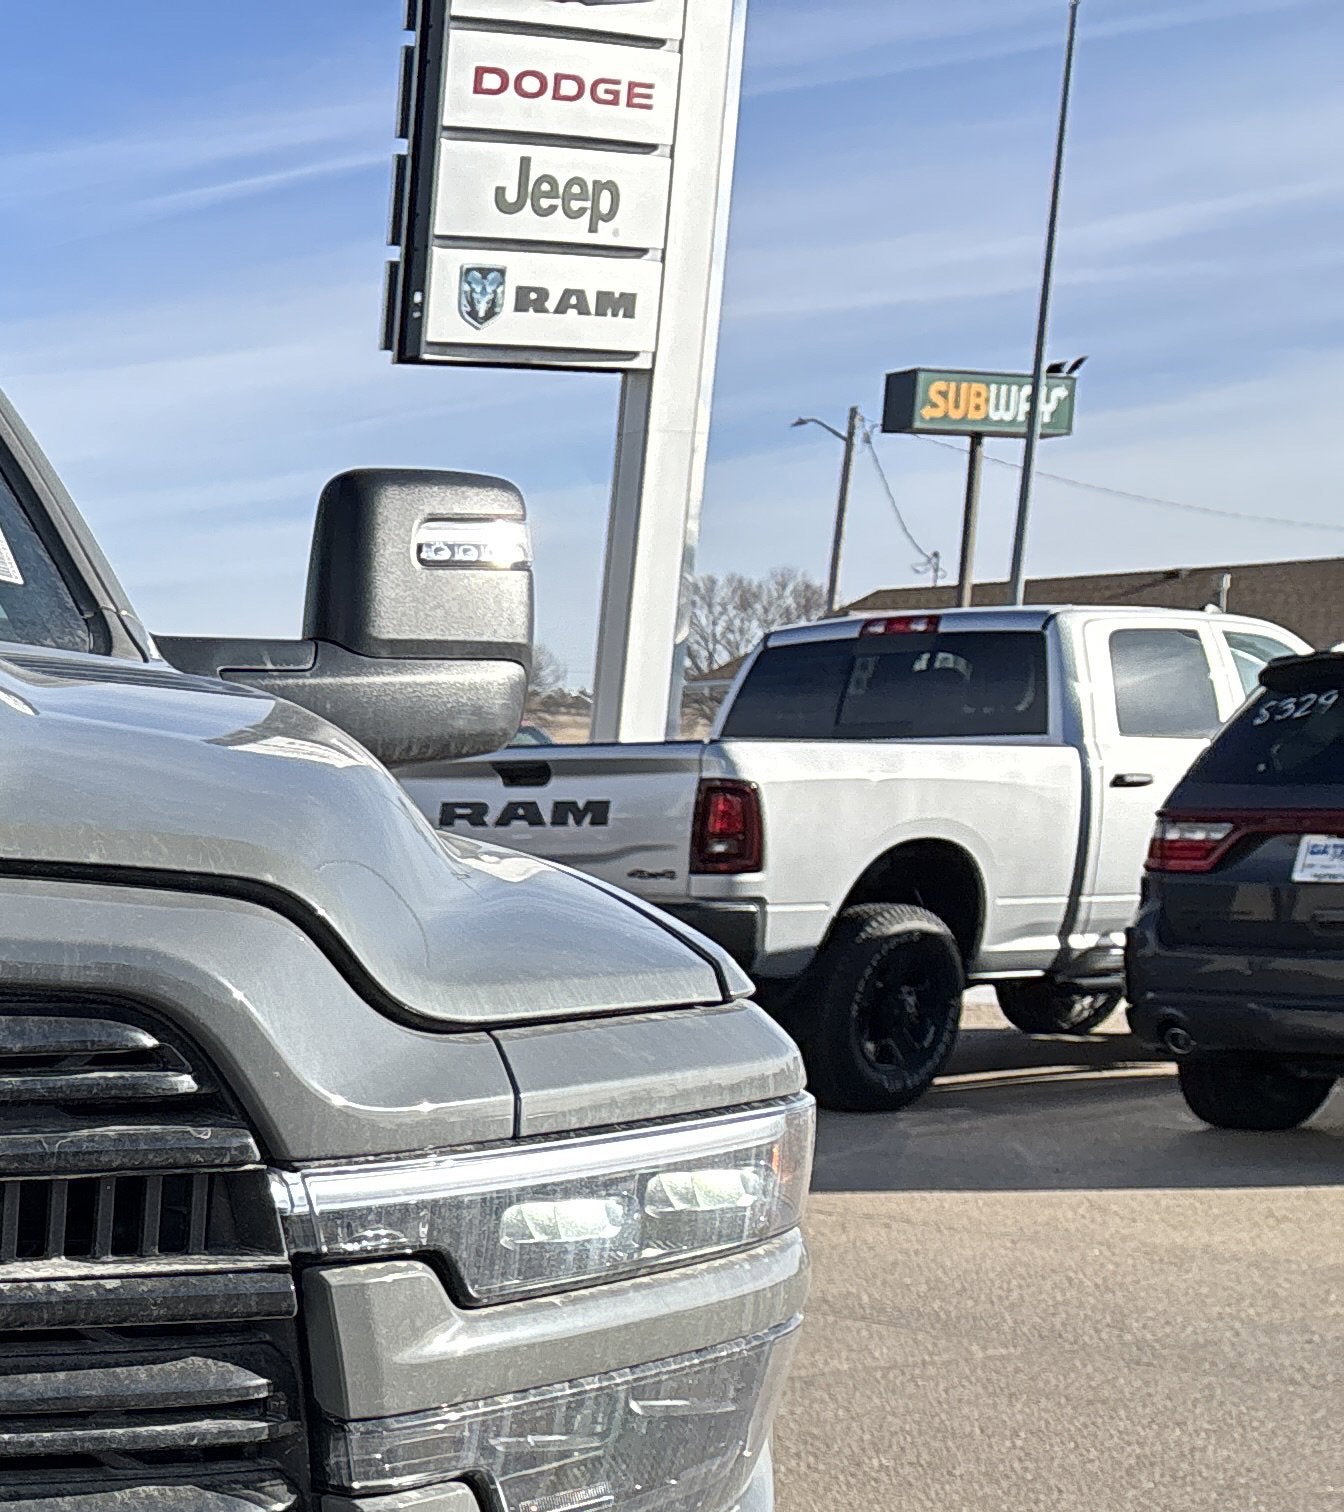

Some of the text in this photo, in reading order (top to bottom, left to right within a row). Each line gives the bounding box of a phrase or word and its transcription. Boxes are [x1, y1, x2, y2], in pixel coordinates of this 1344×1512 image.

[472, 65, 655, 110] DODGE
[494, 155, 621, 233] Jeep
[513, 285, 638, 319] RAM
[438, 799, 611, 828] RAM
